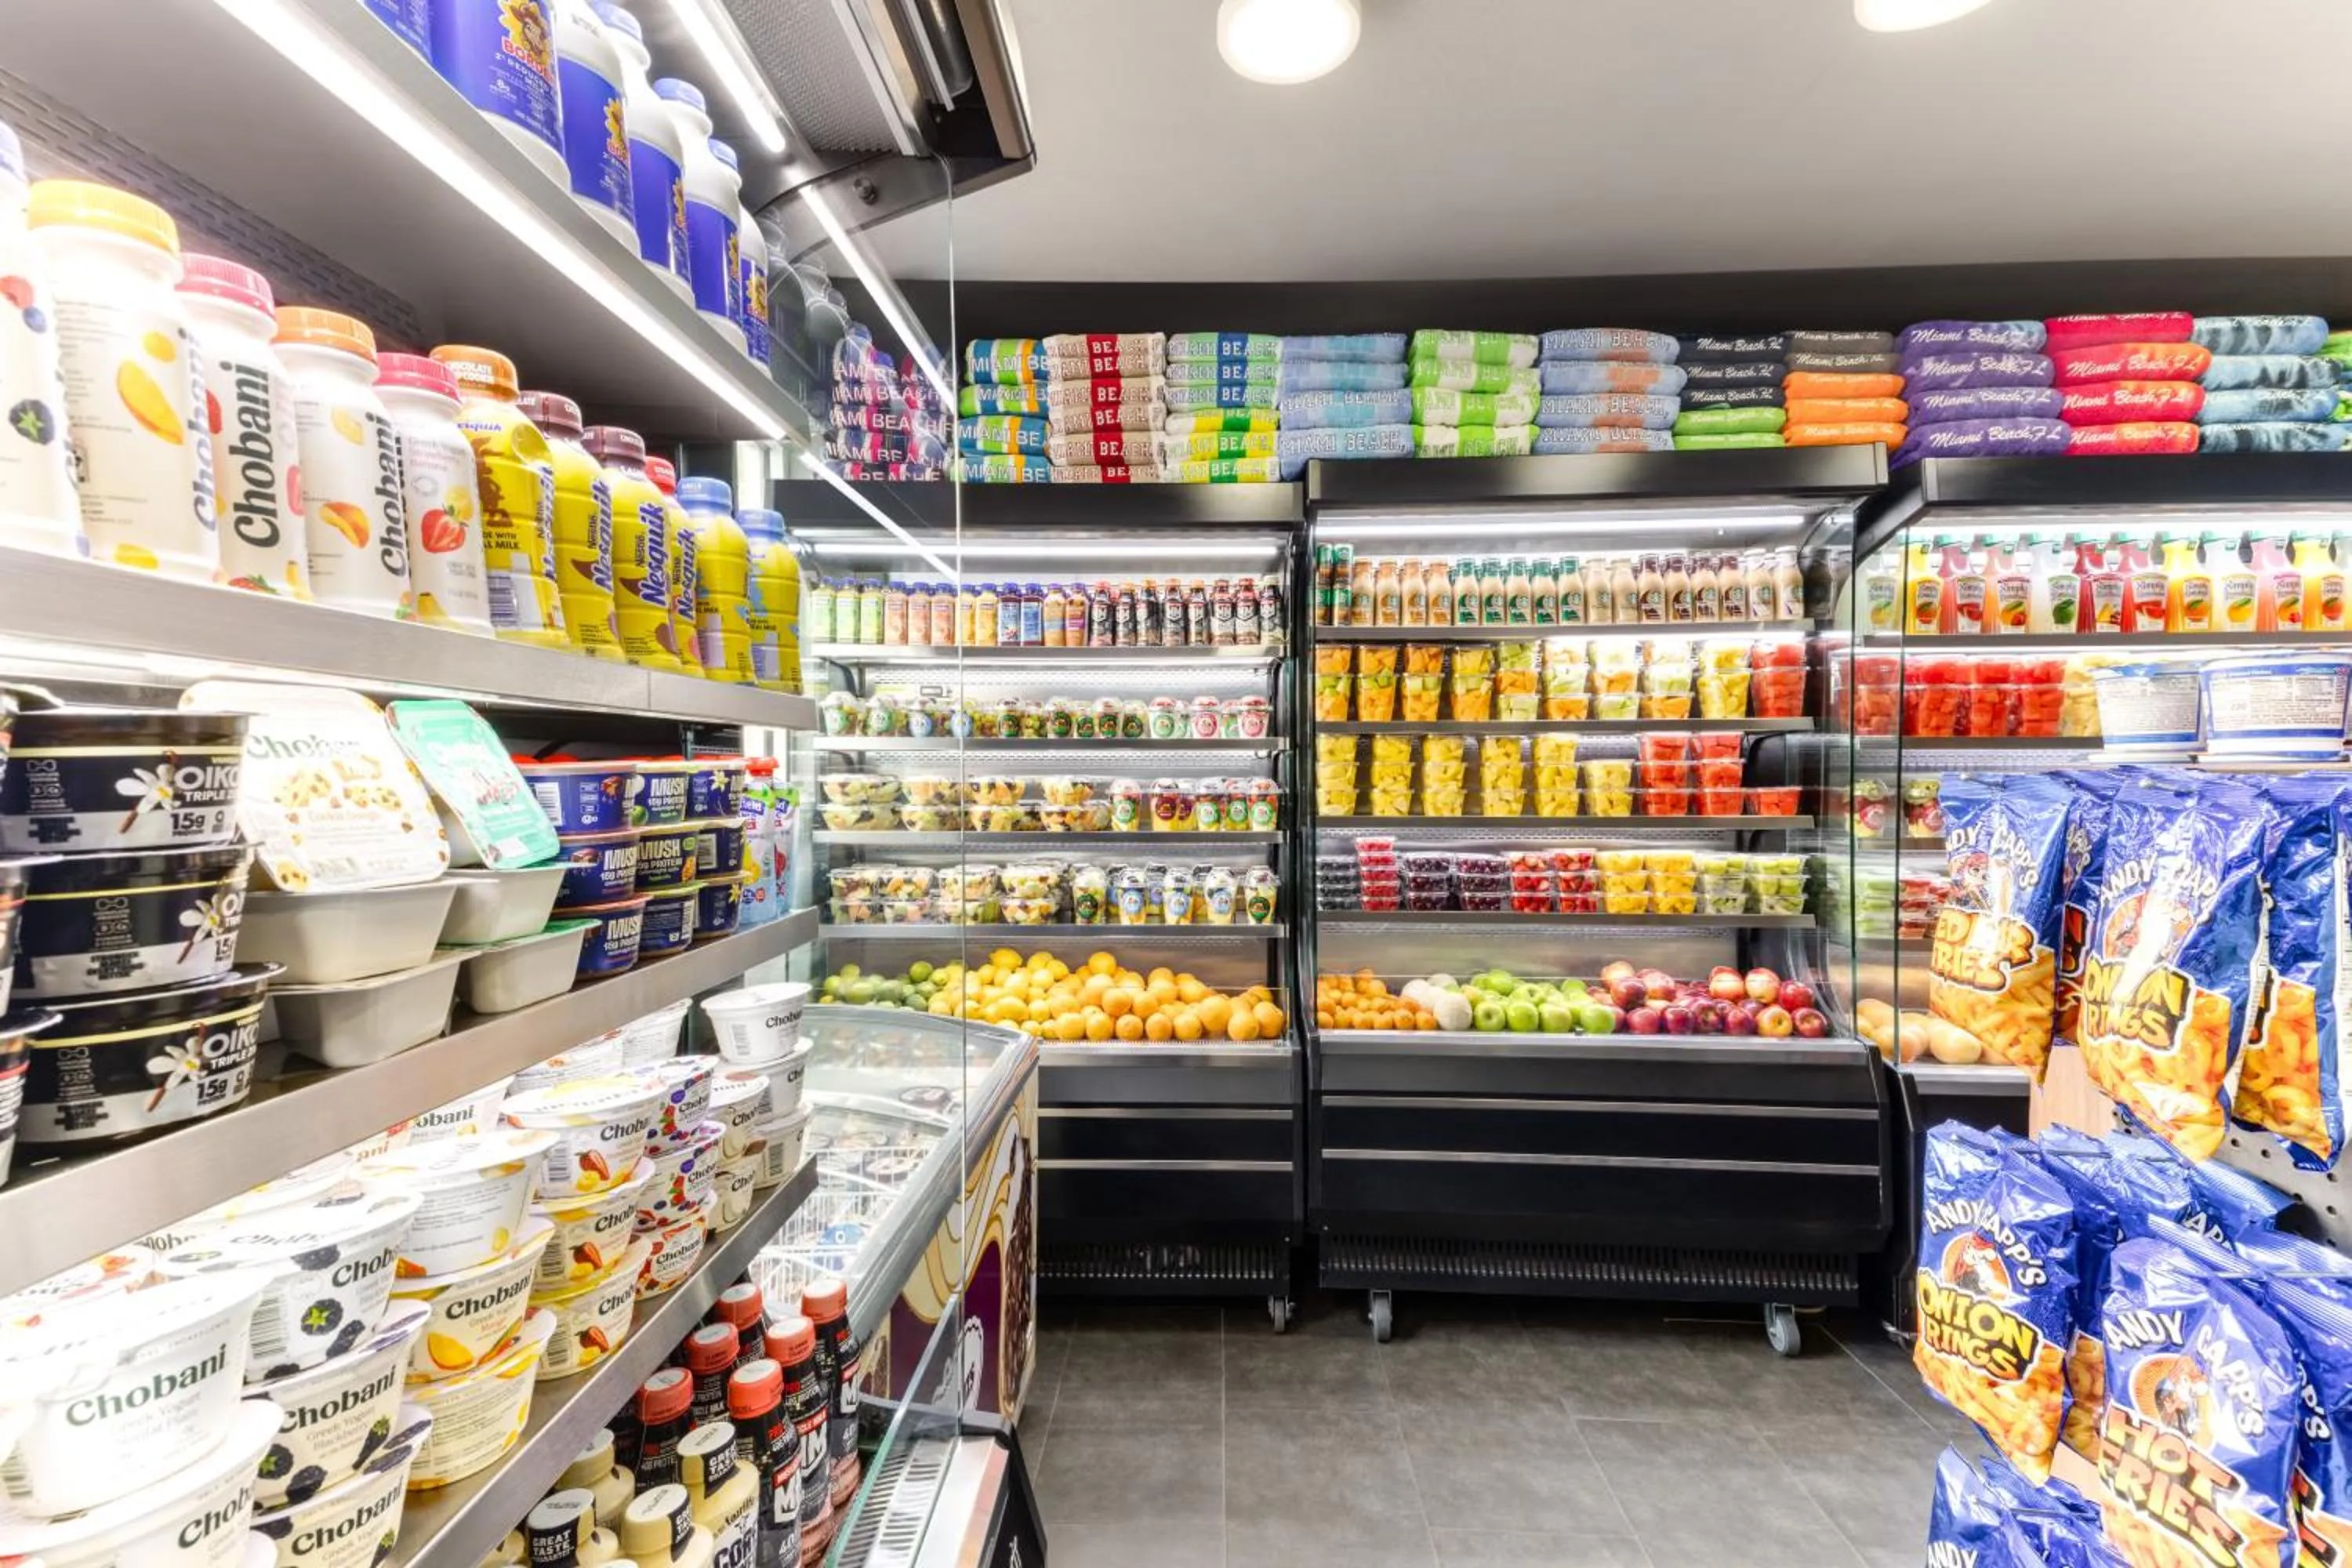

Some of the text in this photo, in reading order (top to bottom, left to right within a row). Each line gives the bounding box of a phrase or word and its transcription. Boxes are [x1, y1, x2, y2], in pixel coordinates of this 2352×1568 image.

[1697, 337, 1733, 351] Miami
[1911, 328, 1963, 343] Miami
[971, 355, 1022, 372] MIAMI
[1687, 365, 1723, 379] Miami
[1923, 357, 1976, 376] Miami
[2066, 360, 2122, 377] Miami
[1690, 390, 1726, 403] Miami
[1923, 394, 1976, 408] Miami
[2063, 392, 2108, 408] Miami
[959, 423, 1011, 443] MIAMI
[1929, 431, 1983, 448] Miami
[2070, 428, 2117, 445] Miami
[218, 360, 281, 549] Chobani
[365, 412, 407, 578] Chobani
[590, 478, 613, 593] Nesquik
[638, 500, 668, 607] Nesquik
[677, 528, 696, 622] Nesquik
[174, 765, 240, 790] OIKO
[183, 790, 224, 802] TRIPLE
[171, 812, 205, 831] 15g
[603, 846, 637, 871] MUS
[606, 913, 642, 941] MUS
[201, 1025, 260, 1059] OIKO
[209, 1048, 249, 1070] TRIPLE
[196, 1079, 227, 1098] 15g
[412, 1104, 474, 1129] obani
[1925, 1198, 1984, 1236] ANDY
[445, 1266, 534, 1321] Chobani
[1918, 1269, 2035, 1363] ONION
[1925, 1315, 2021, 1382] RINGS
[65, 1342, 227, 1428] Chobani
[2103, 1309, 2266, 1439] ANDY CAPP'S
[278, 1363, 397, 1435] Chobani
[2107, 1408, 2241, 1499] HOT
[290, 1473, 405, 1557] Chobani
[2097, 1444, 2244, 1568] FRIES
[532, 1529, 572, 1548] GREAT
[532, 1540, 572, 1557] TASTE
